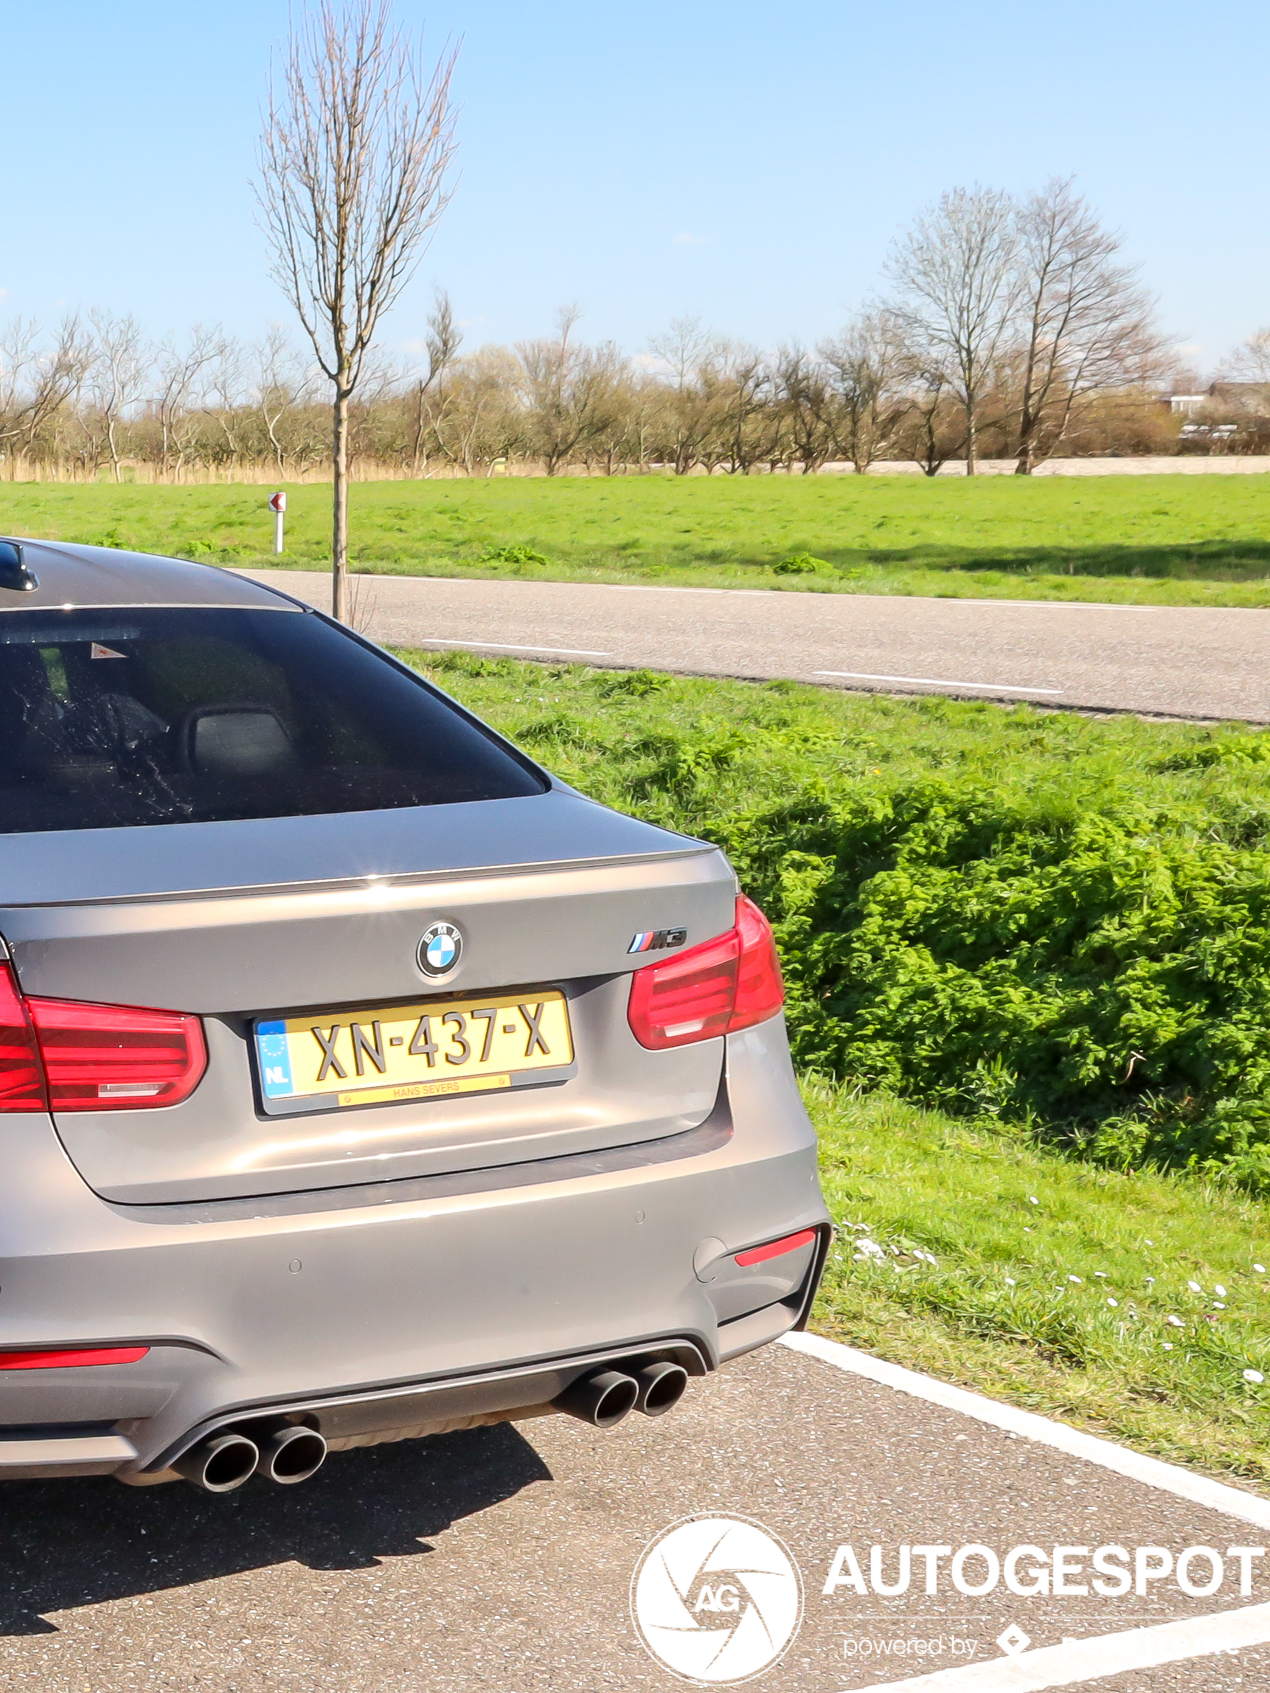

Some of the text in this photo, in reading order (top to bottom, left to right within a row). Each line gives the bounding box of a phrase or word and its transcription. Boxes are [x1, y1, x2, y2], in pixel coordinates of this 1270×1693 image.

[423, 925, 460, 944] BMW
[641, 926, 687, 951] M3
[311, 1003, 551, 1082] XN-437-X
[265, 1066, 289, 1085] NL
[393, 1082, 460, 1098] HANS SEVERS
